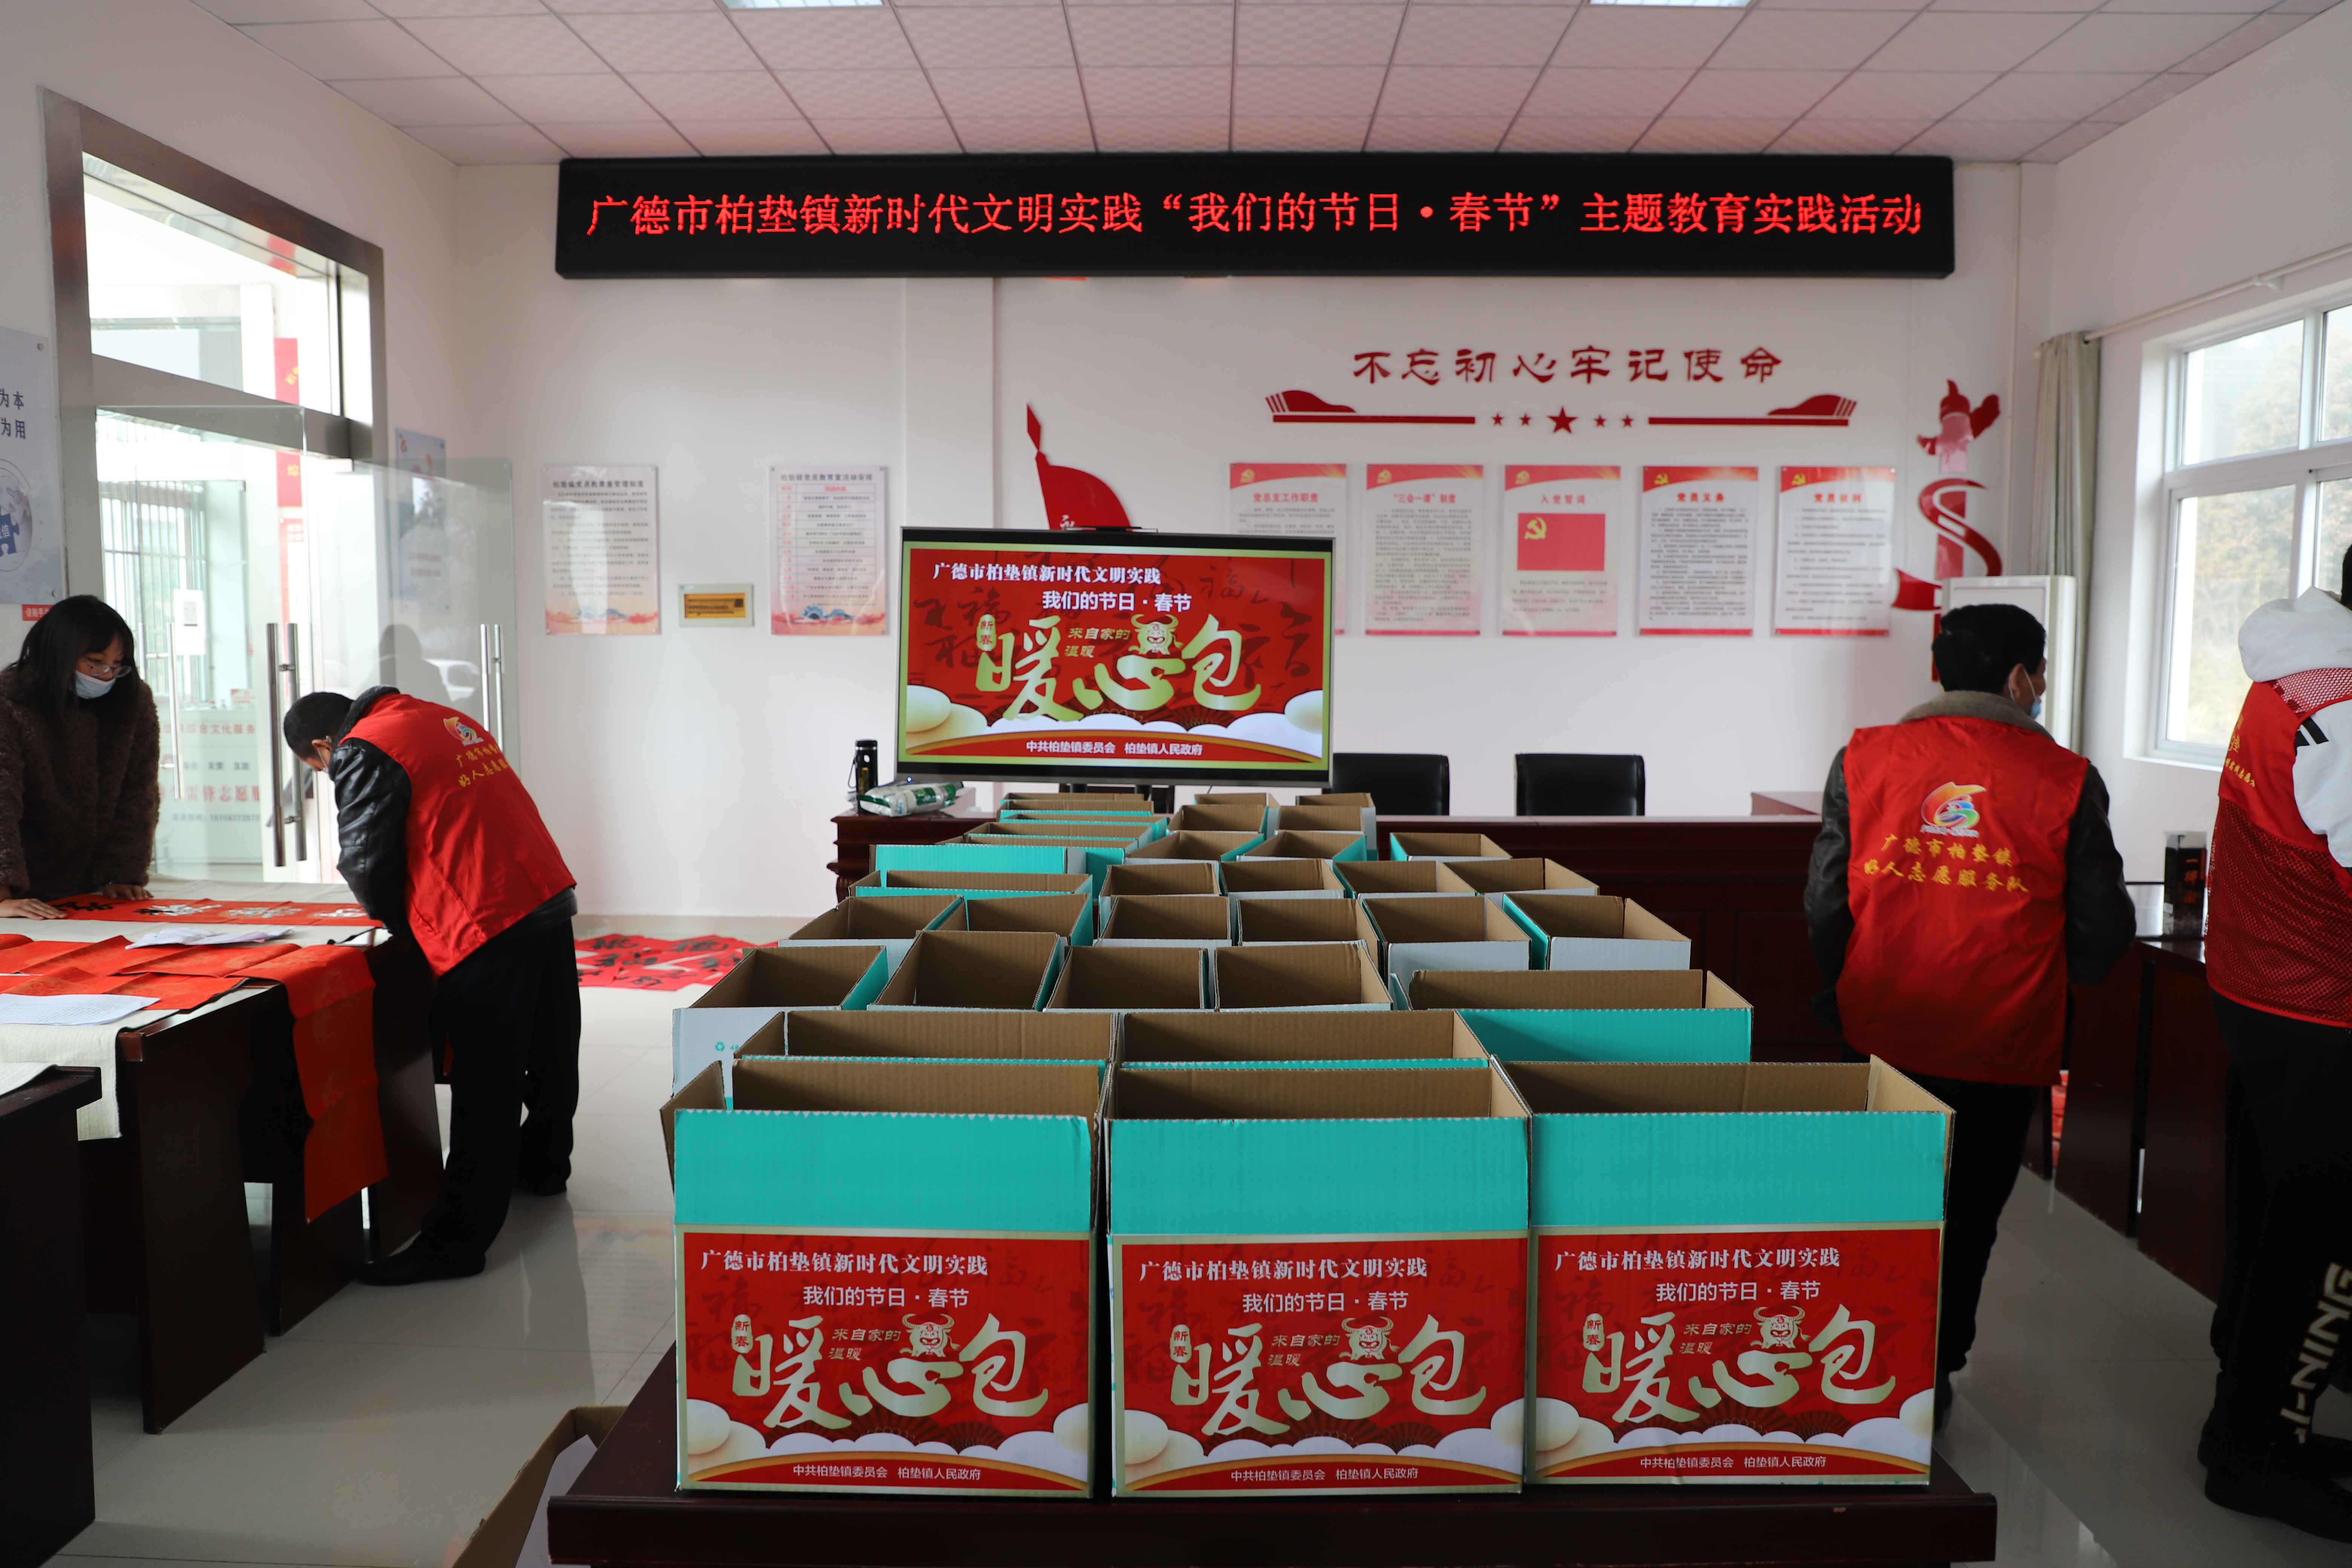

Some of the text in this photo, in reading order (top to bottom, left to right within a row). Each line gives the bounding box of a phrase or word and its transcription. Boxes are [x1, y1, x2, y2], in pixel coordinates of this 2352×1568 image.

[1354, 345, 1782, 385] 不忘初心牢记使命
[1253, 492, 1319, 503] 党总支工作职责
[1677, 492, 1725, 503] 党员义务
[933, 563, 1161, 585] 广德市柏垫镇新时代文明实践
[1043, 591, 1192, 612] 我们的节日·春节
[980, 621, 994, 645] 新春
[1068, 627, 1131, 640] 来自家的
[1065, 646, 1095, 658] 温暖
[975, 614, 1261, 721] 暖心包
[1027, 741, 1203, 756] 中共柏垫镇委员会 柏垫镇人民政府
[1880, 833, 2012, 867] 广德市柏垫镇
[1864, 858, 2029, 893] 好人志愿服务队
[701, 1250, 988, 1276] 广德市柏垫镇新时代文明实践
[1139, 1257, 1428, 1282] 广德市柏垫镇新时代文明实践
[1555, 1248, 1841, 1271] 广德市柏垫镇新时代文明实践
[803, 1286, 969, 1308] 我们的节日·春节
[1242, 1291, 1409, 1313] 我们的节日·春节
[1656, 1281, 1821, 1302] 我们的节日·春节
[735, 1321, 750, 1346] 新春
[832, 1328, 900, 1342] 来自家的
[1586, 1319, 1602, 1346] 新春
[1683, 1323, 1752, 1335] 来自家的
[1173, 1329, 1189, 1358] 新春
[1271, 1334, 1340, 1348] 来自家的
[1680, 1342, 1712, 1355] 温暖
[828, 1348, 862, 1361] 温暖
[1268, 1354, 1301, 1367] 温暖
[1583, 1303, 1896, 1423] 暖心包
[732, 1313, 1048, 1429] 暖心包
[1171, 1314, 1486, 1436] 暖心包
[793, 1464, 982, 1481] 中共柏垫镇委员会 柏垫镇人民政府
[1640, 1456, 1827, 1469] 中共柏垫镇委员会 柏垫镇人民政府
[1231, 1468, 1419, 1481] 中共柏垫镇委员会 柏垫镇人民政府
